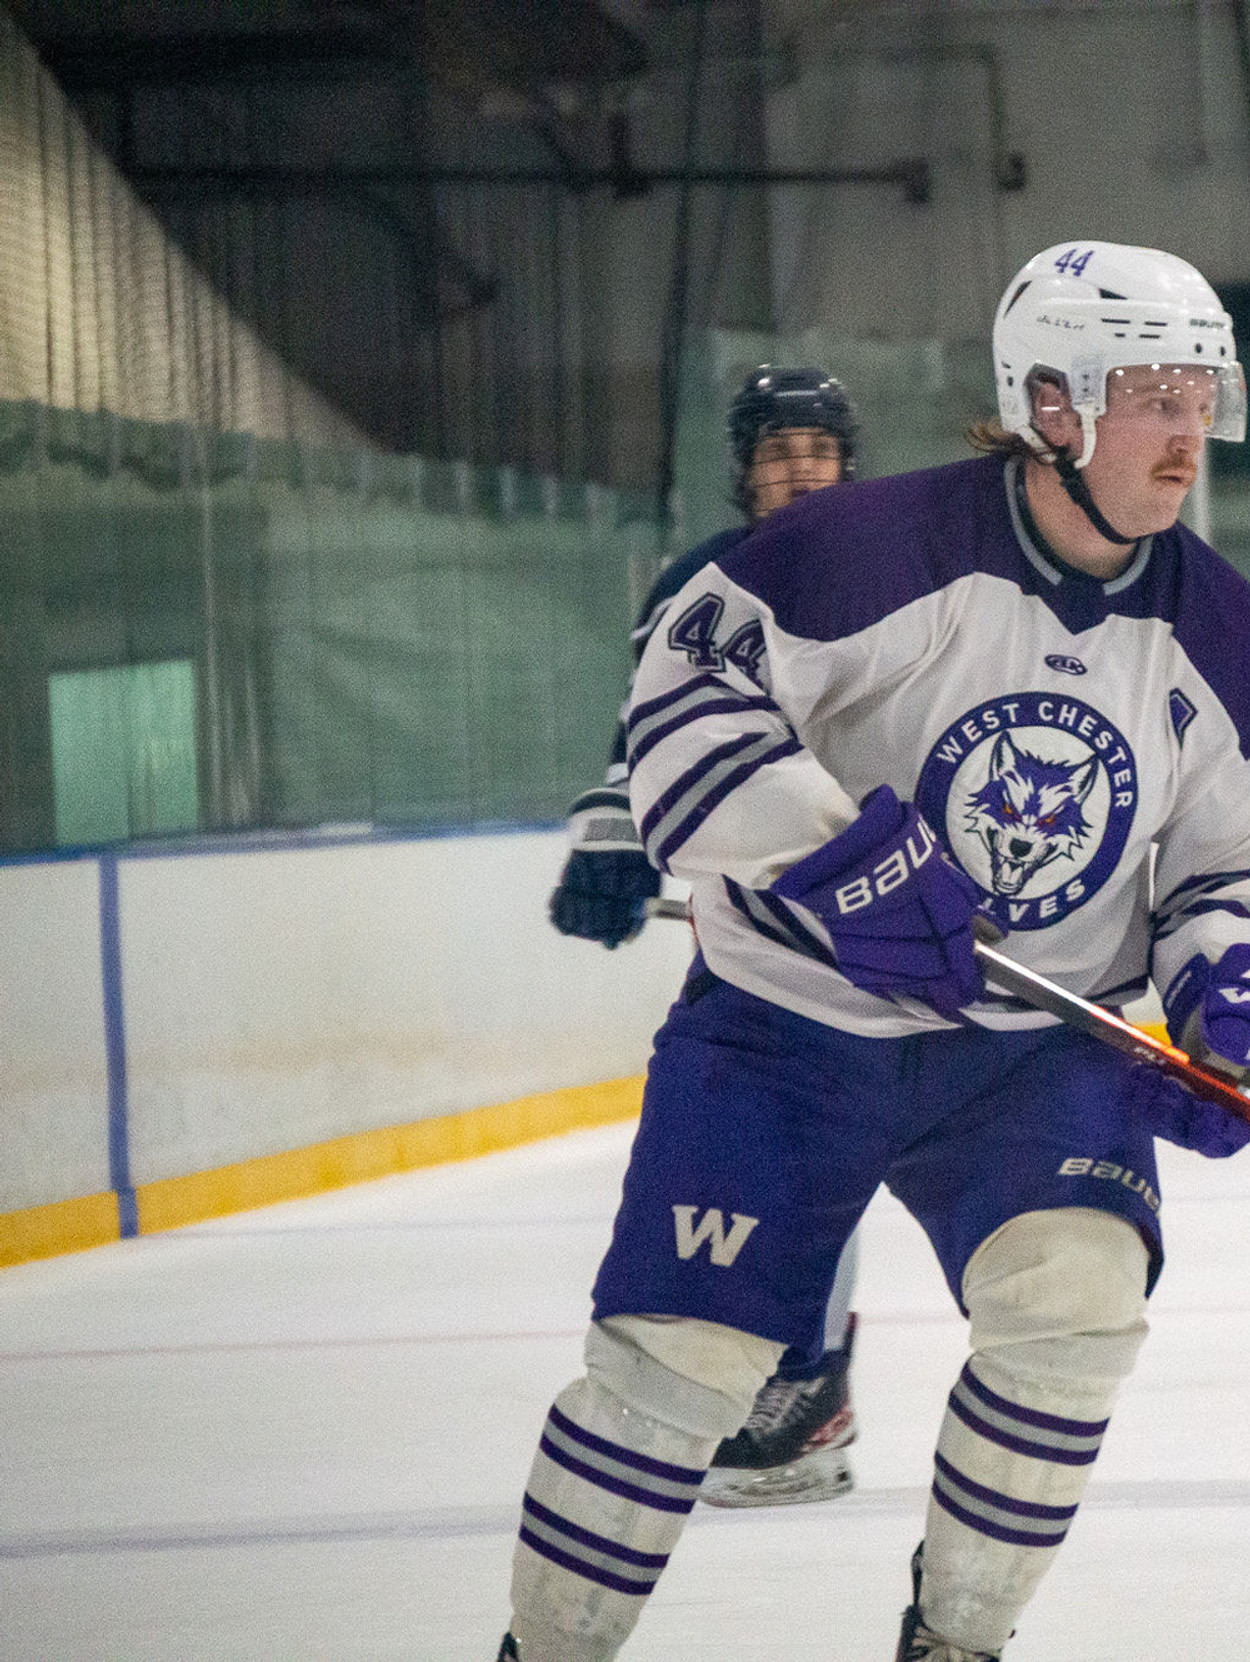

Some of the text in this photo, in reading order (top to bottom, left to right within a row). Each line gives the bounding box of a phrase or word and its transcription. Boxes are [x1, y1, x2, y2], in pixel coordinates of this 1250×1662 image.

[1054, 248, 1094, 277] 44
[936, 701, 1134, 809] WEST CHESTER
[672, 1204, 760, 1267] W
